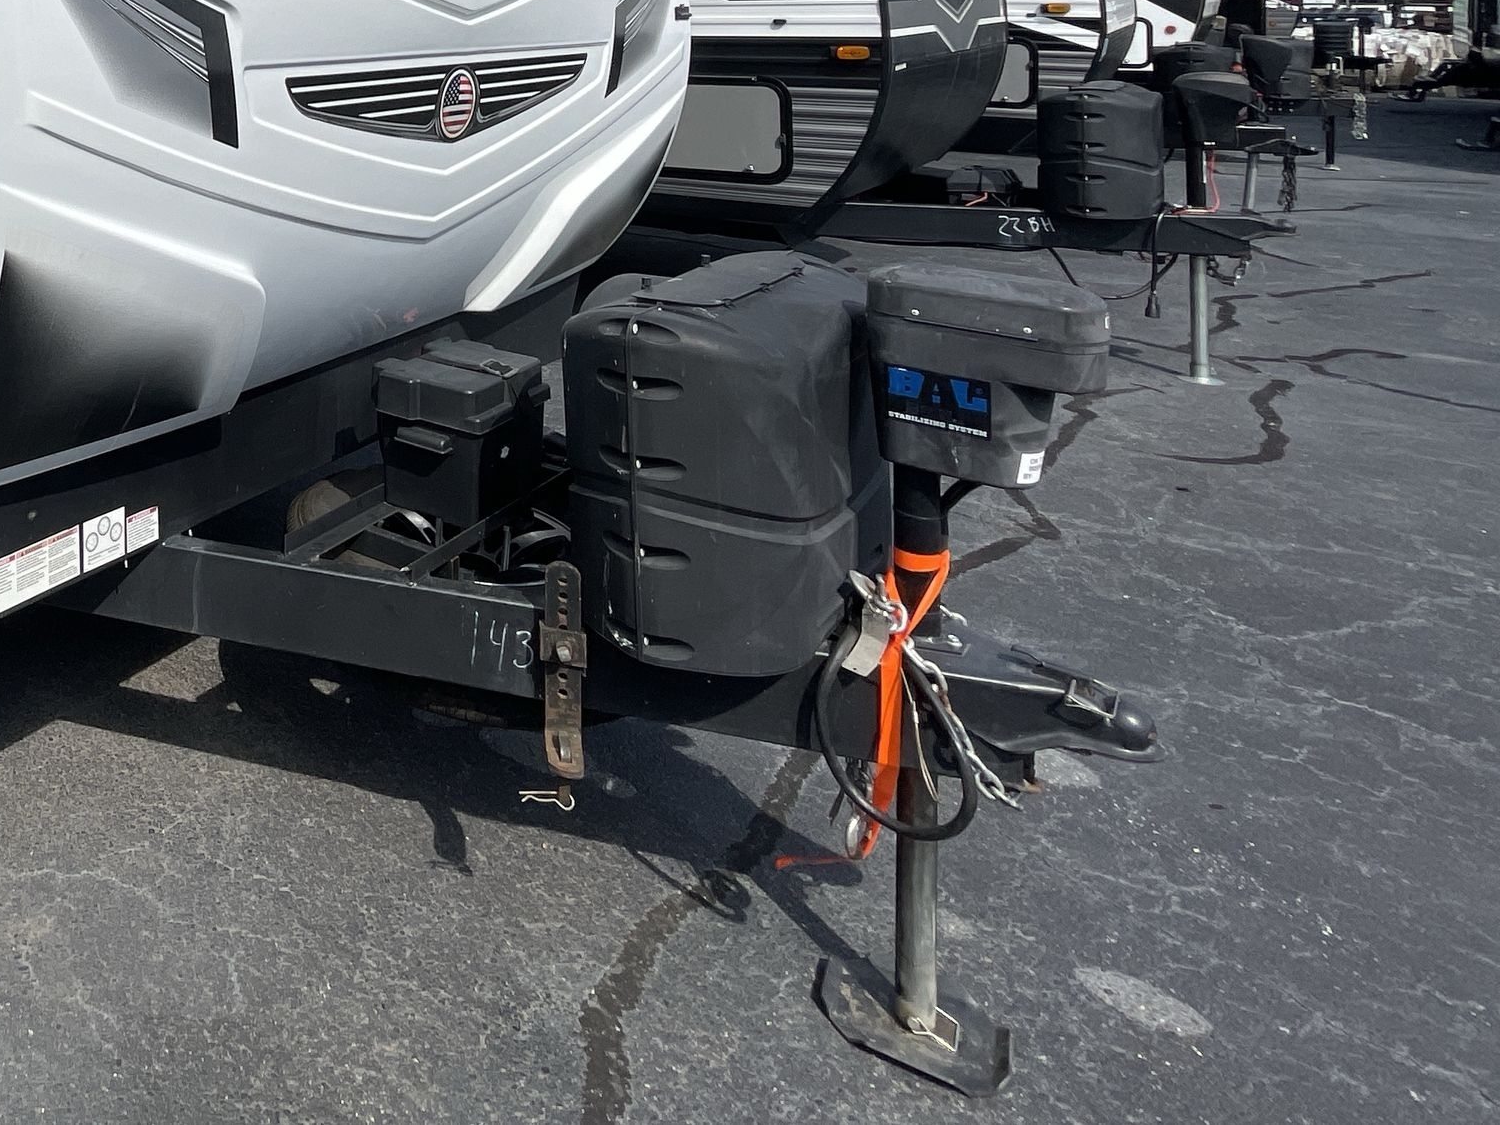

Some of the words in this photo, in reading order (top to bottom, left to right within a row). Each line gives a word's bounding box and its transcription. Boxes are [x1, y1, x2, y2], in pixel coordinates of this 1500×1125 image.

[888, 410, 946, 429] STABILIZING
[948, 423, 988, 438] SYSTEM
[470, 610, 535, 673] 143
